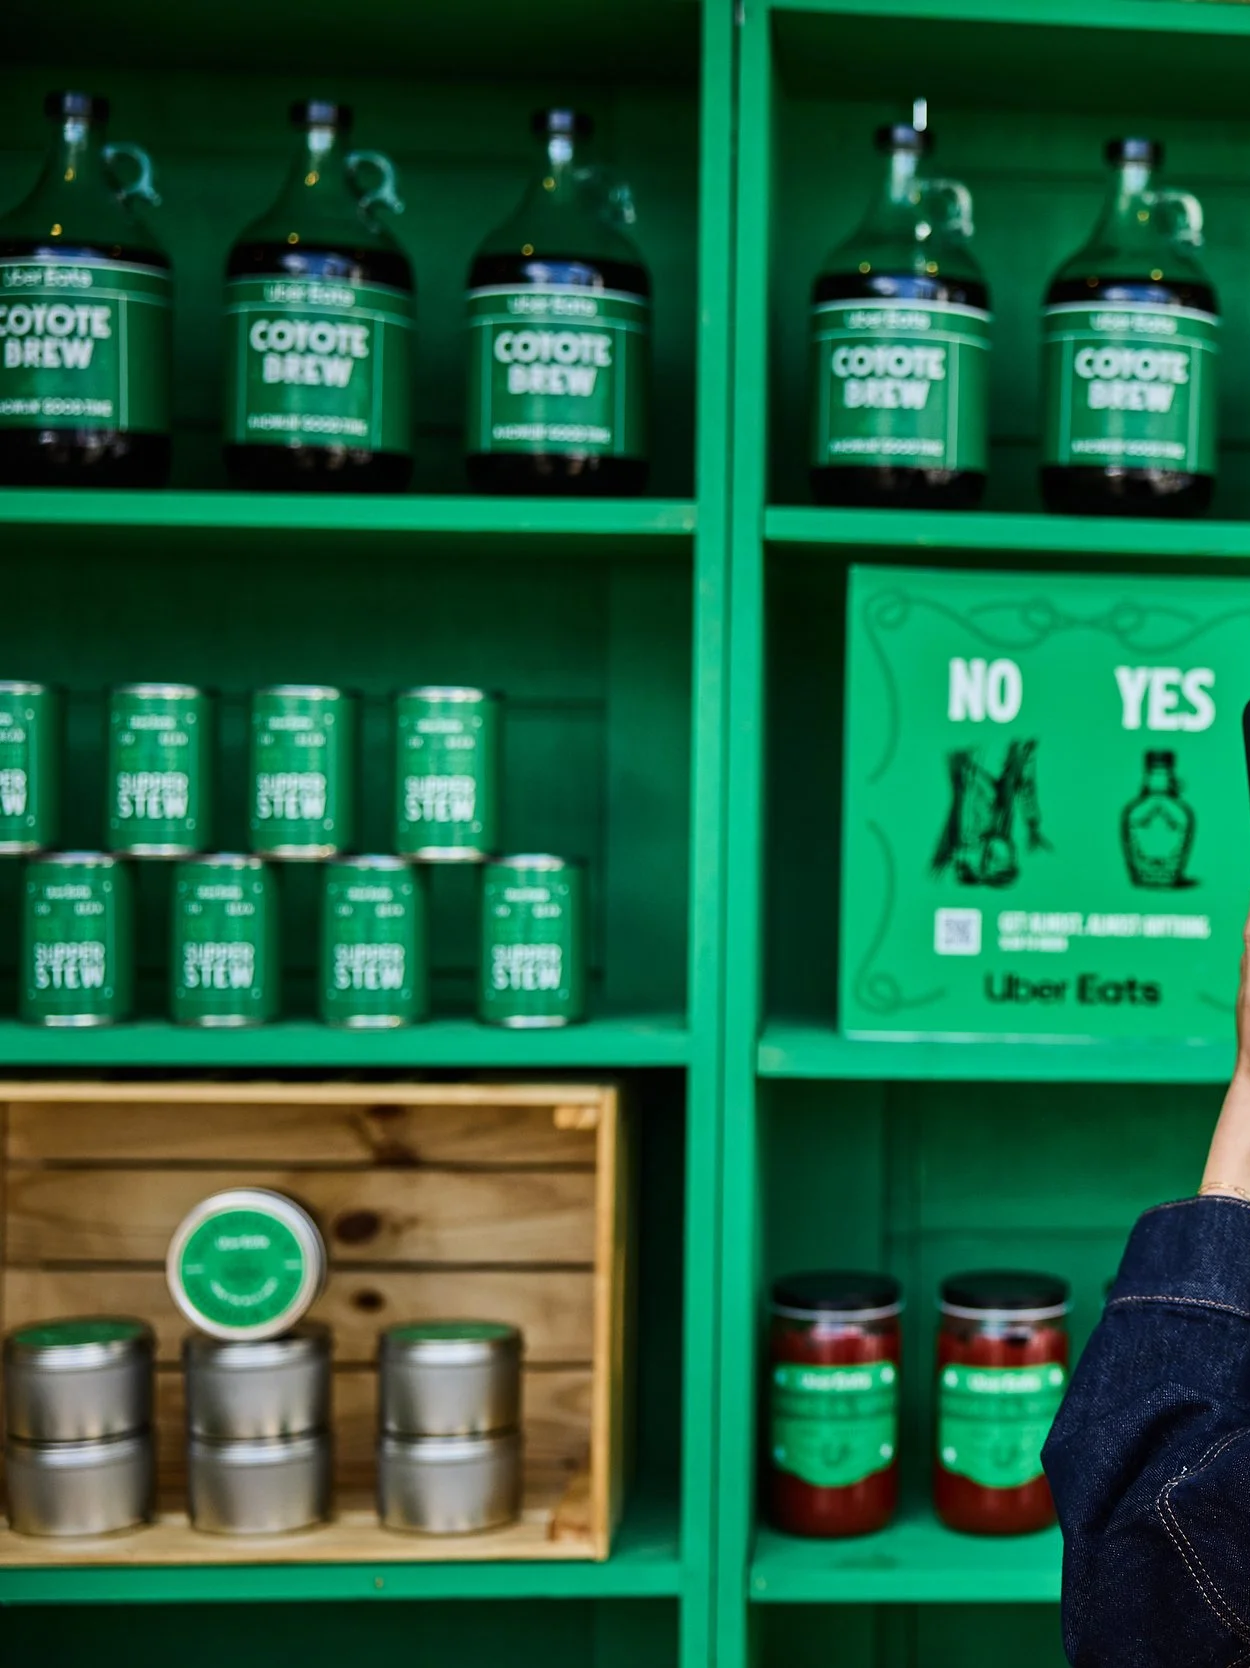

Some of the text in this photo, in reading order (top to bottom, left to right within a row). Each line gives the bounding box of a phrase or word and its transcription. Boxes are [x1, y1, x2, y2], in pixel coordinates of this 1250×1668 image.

[3, 337, 95, 370] BREW
[250, 319, 370, 358] COYOTE
[494, 330, 612, 367] COYOTE
[262, 351, 356, 388] BREW
[507, 363, 598, 397] BREW
[831, 345, 946, 380] COYOTE
[1074, 346, 1190, 385] COYOTE
[843, 377, 931, 410] BREW
[1087, 380, 1176, 413] BREW
[947, 656, 1023, 723] NO
[1114, 665, 1216, 732] YES
[116, 797, 189, 820] STEW
[34, 965, 105, 989] STEW
[182, 965, 255, 989] STEW
[983, 971, 1163, 1007] Uber Eats
